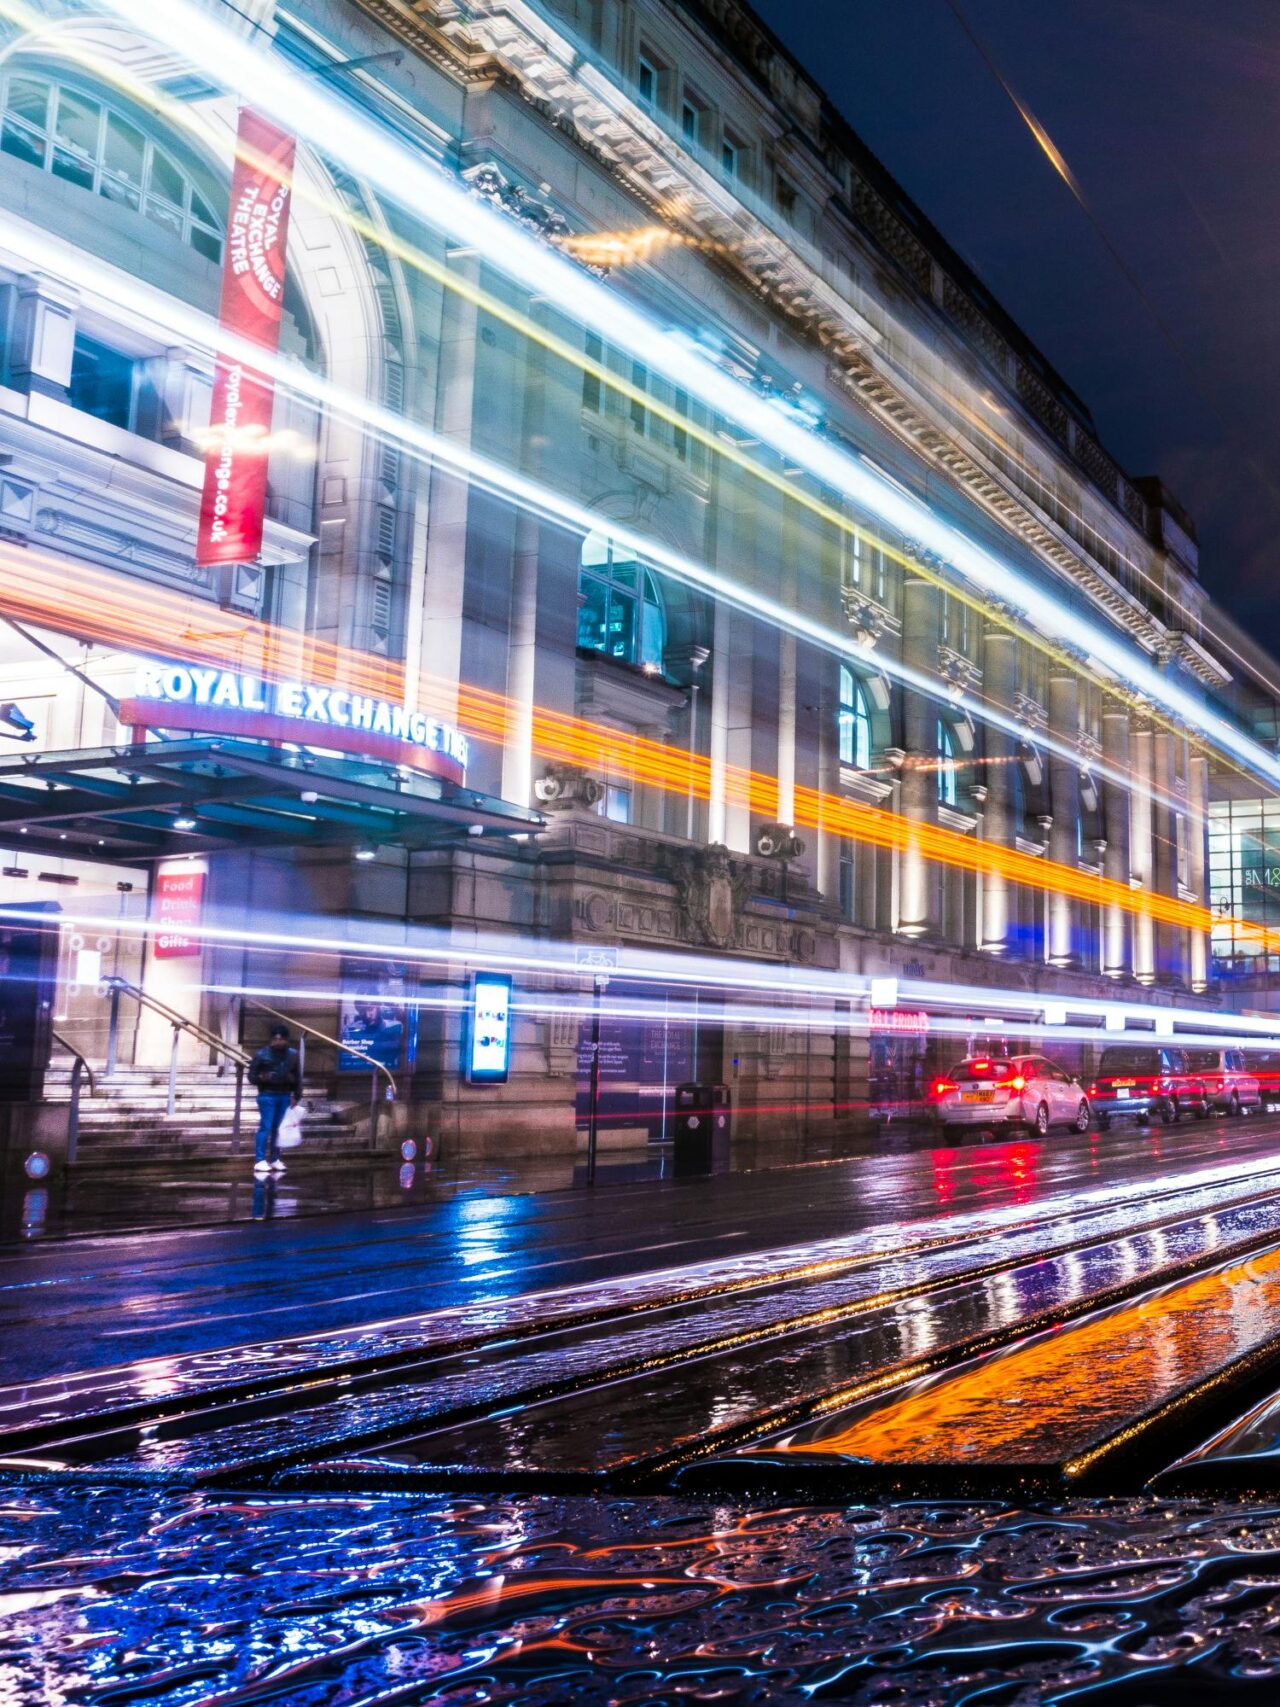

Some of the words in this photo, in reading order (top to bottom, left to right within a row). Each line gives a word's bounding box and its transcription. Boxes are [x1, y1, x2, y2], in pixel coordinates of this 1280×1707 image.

[230, 186, 260, 275] THEATRE
[247, 203, 281, 299] EXCHANGE
[264, 182, 289, 251] ROYAL
[210, 364, 242, 543] royalexange.co.uk
[135, 665, 264, 711] ROYAL
[278, 681, 439, 749] EXCHANGE
[161, 896, 197, 911] Drink
[162, 877, 194, 892] Food
[158, 934, 190, 949] Gifts
